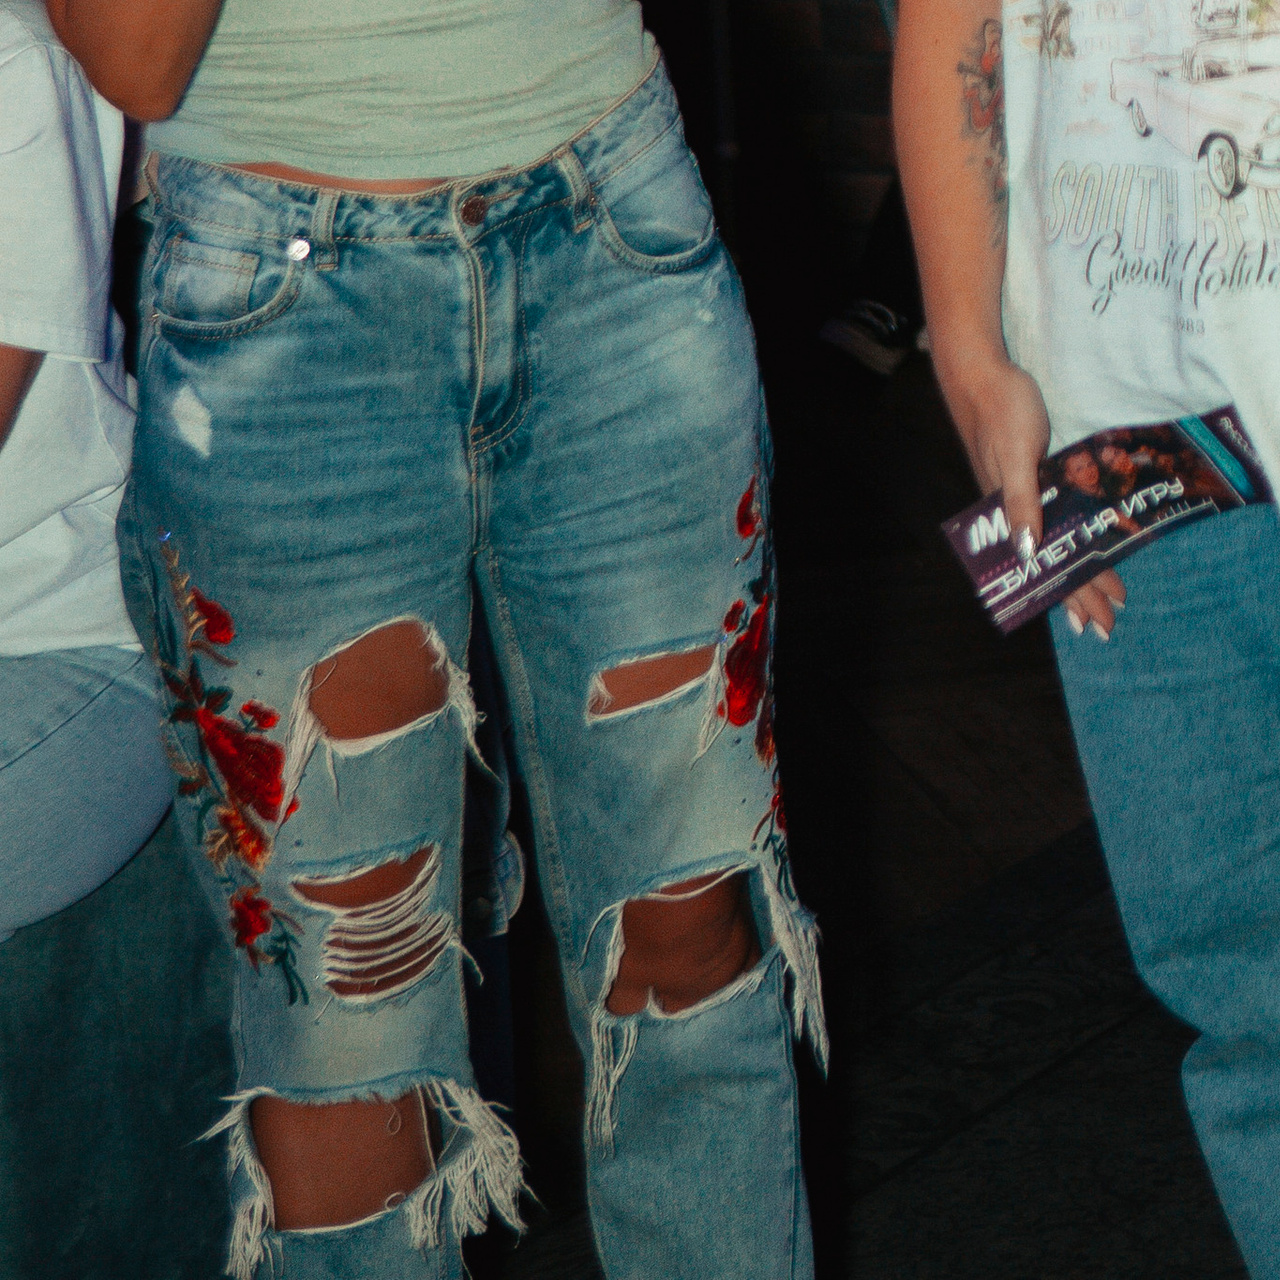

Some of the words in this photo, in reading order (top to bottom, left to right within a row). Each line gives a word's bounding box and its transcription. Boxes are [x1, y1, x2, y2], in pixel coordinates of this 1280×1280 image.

[1047, 159, 1179, 251] SOUTH
[1085, 227, 1179, 315] Great
[978, 529, 1077, 609] БИЛЕТ
[1080, 506, 1120, 542] НА
[1119, 476, 1184, 518] ИГРУ
